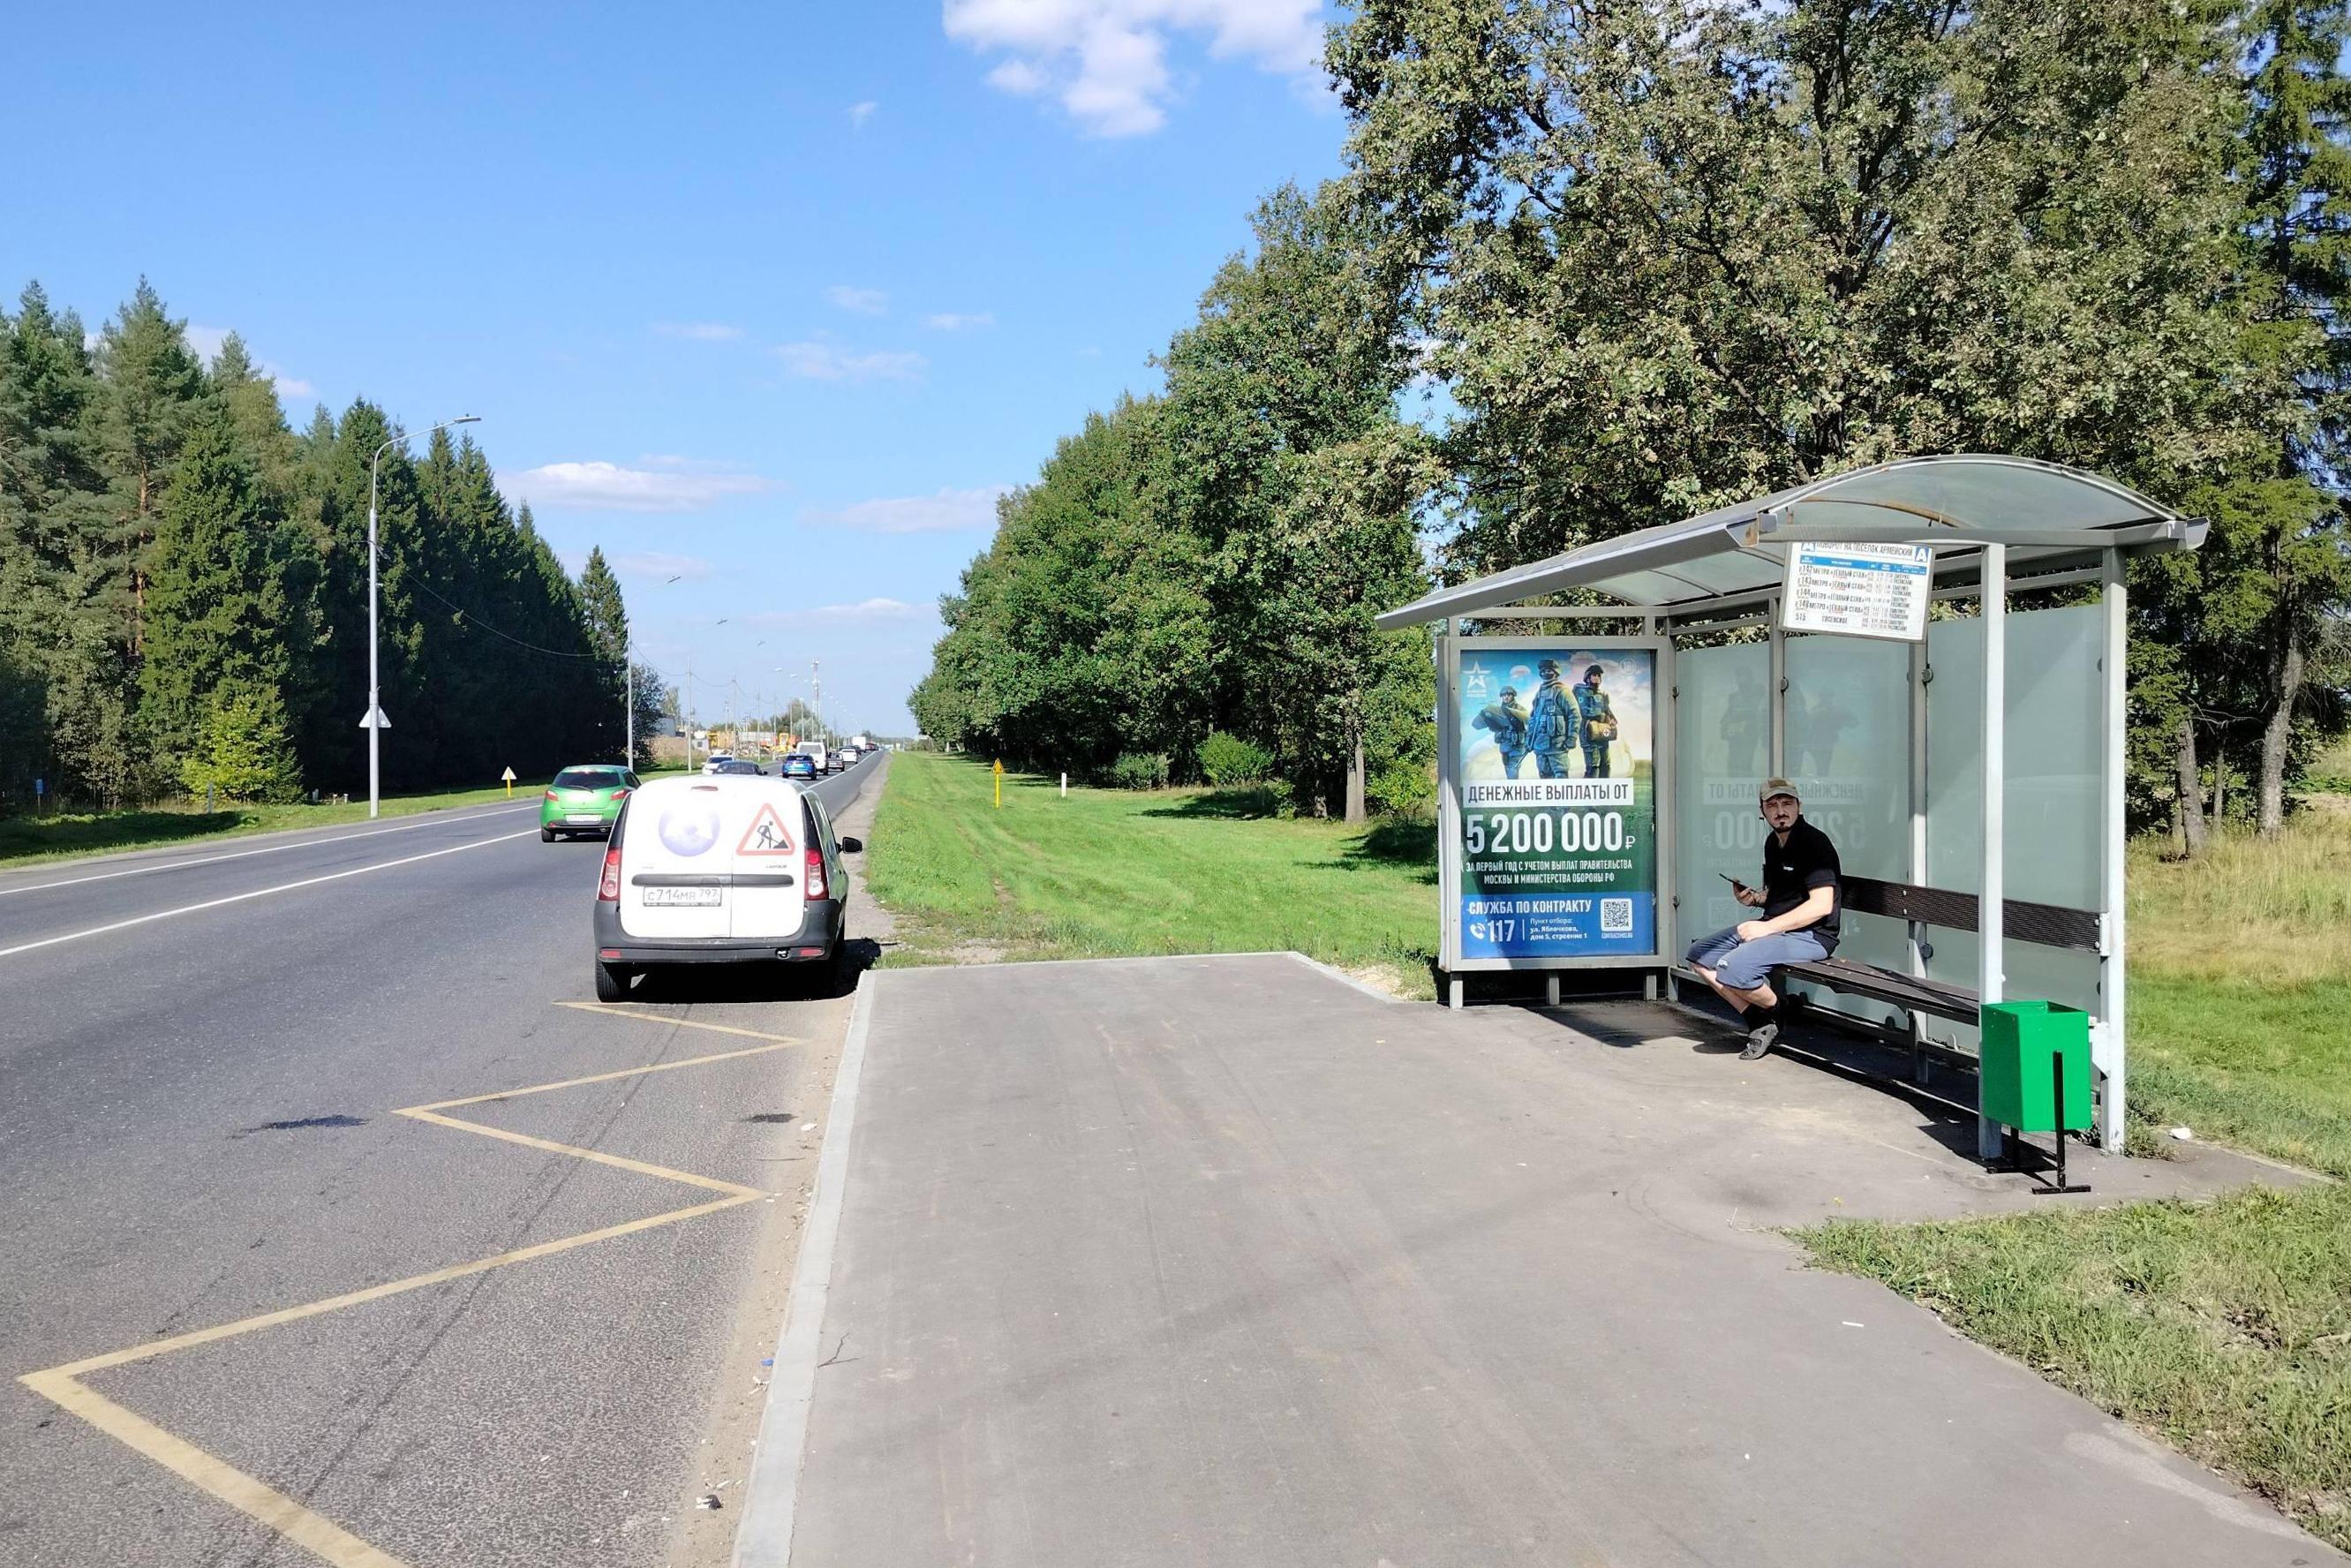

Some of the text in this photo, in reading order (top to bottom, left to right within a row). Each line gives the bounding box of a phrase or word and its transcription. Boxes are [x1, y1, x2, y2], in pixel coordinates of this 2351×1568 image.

[1844, 542, 1852, 551] НА
[1880, 546, 1913, 556] АРМЕЙСКИЙ
[1468, 783, 1628, 803] ДЕНЕЖНЫЕ ВЫПЛАТЫ ОТ
[1466, 814, 1485, 854] 5
[1491, 813, 1553, 853] 200
[1466, 859, 1632, 871] ЗА ПЕРВЫЙ ГОД С УЧЕТОМ ВЫПЛАТ ПРАВИТЕЛЬСТВА
[1484, 872, 1615, 884] МОСКВЫ И МИНИСТЕРСТВА ОБОРОНЫ РФ
[698, 888, 717, 898] 797
[1469, 900, 1592, 915] СЛУЖБА ПО КОНТРАКТУ
[1488, 919, 1515, 942] 117
